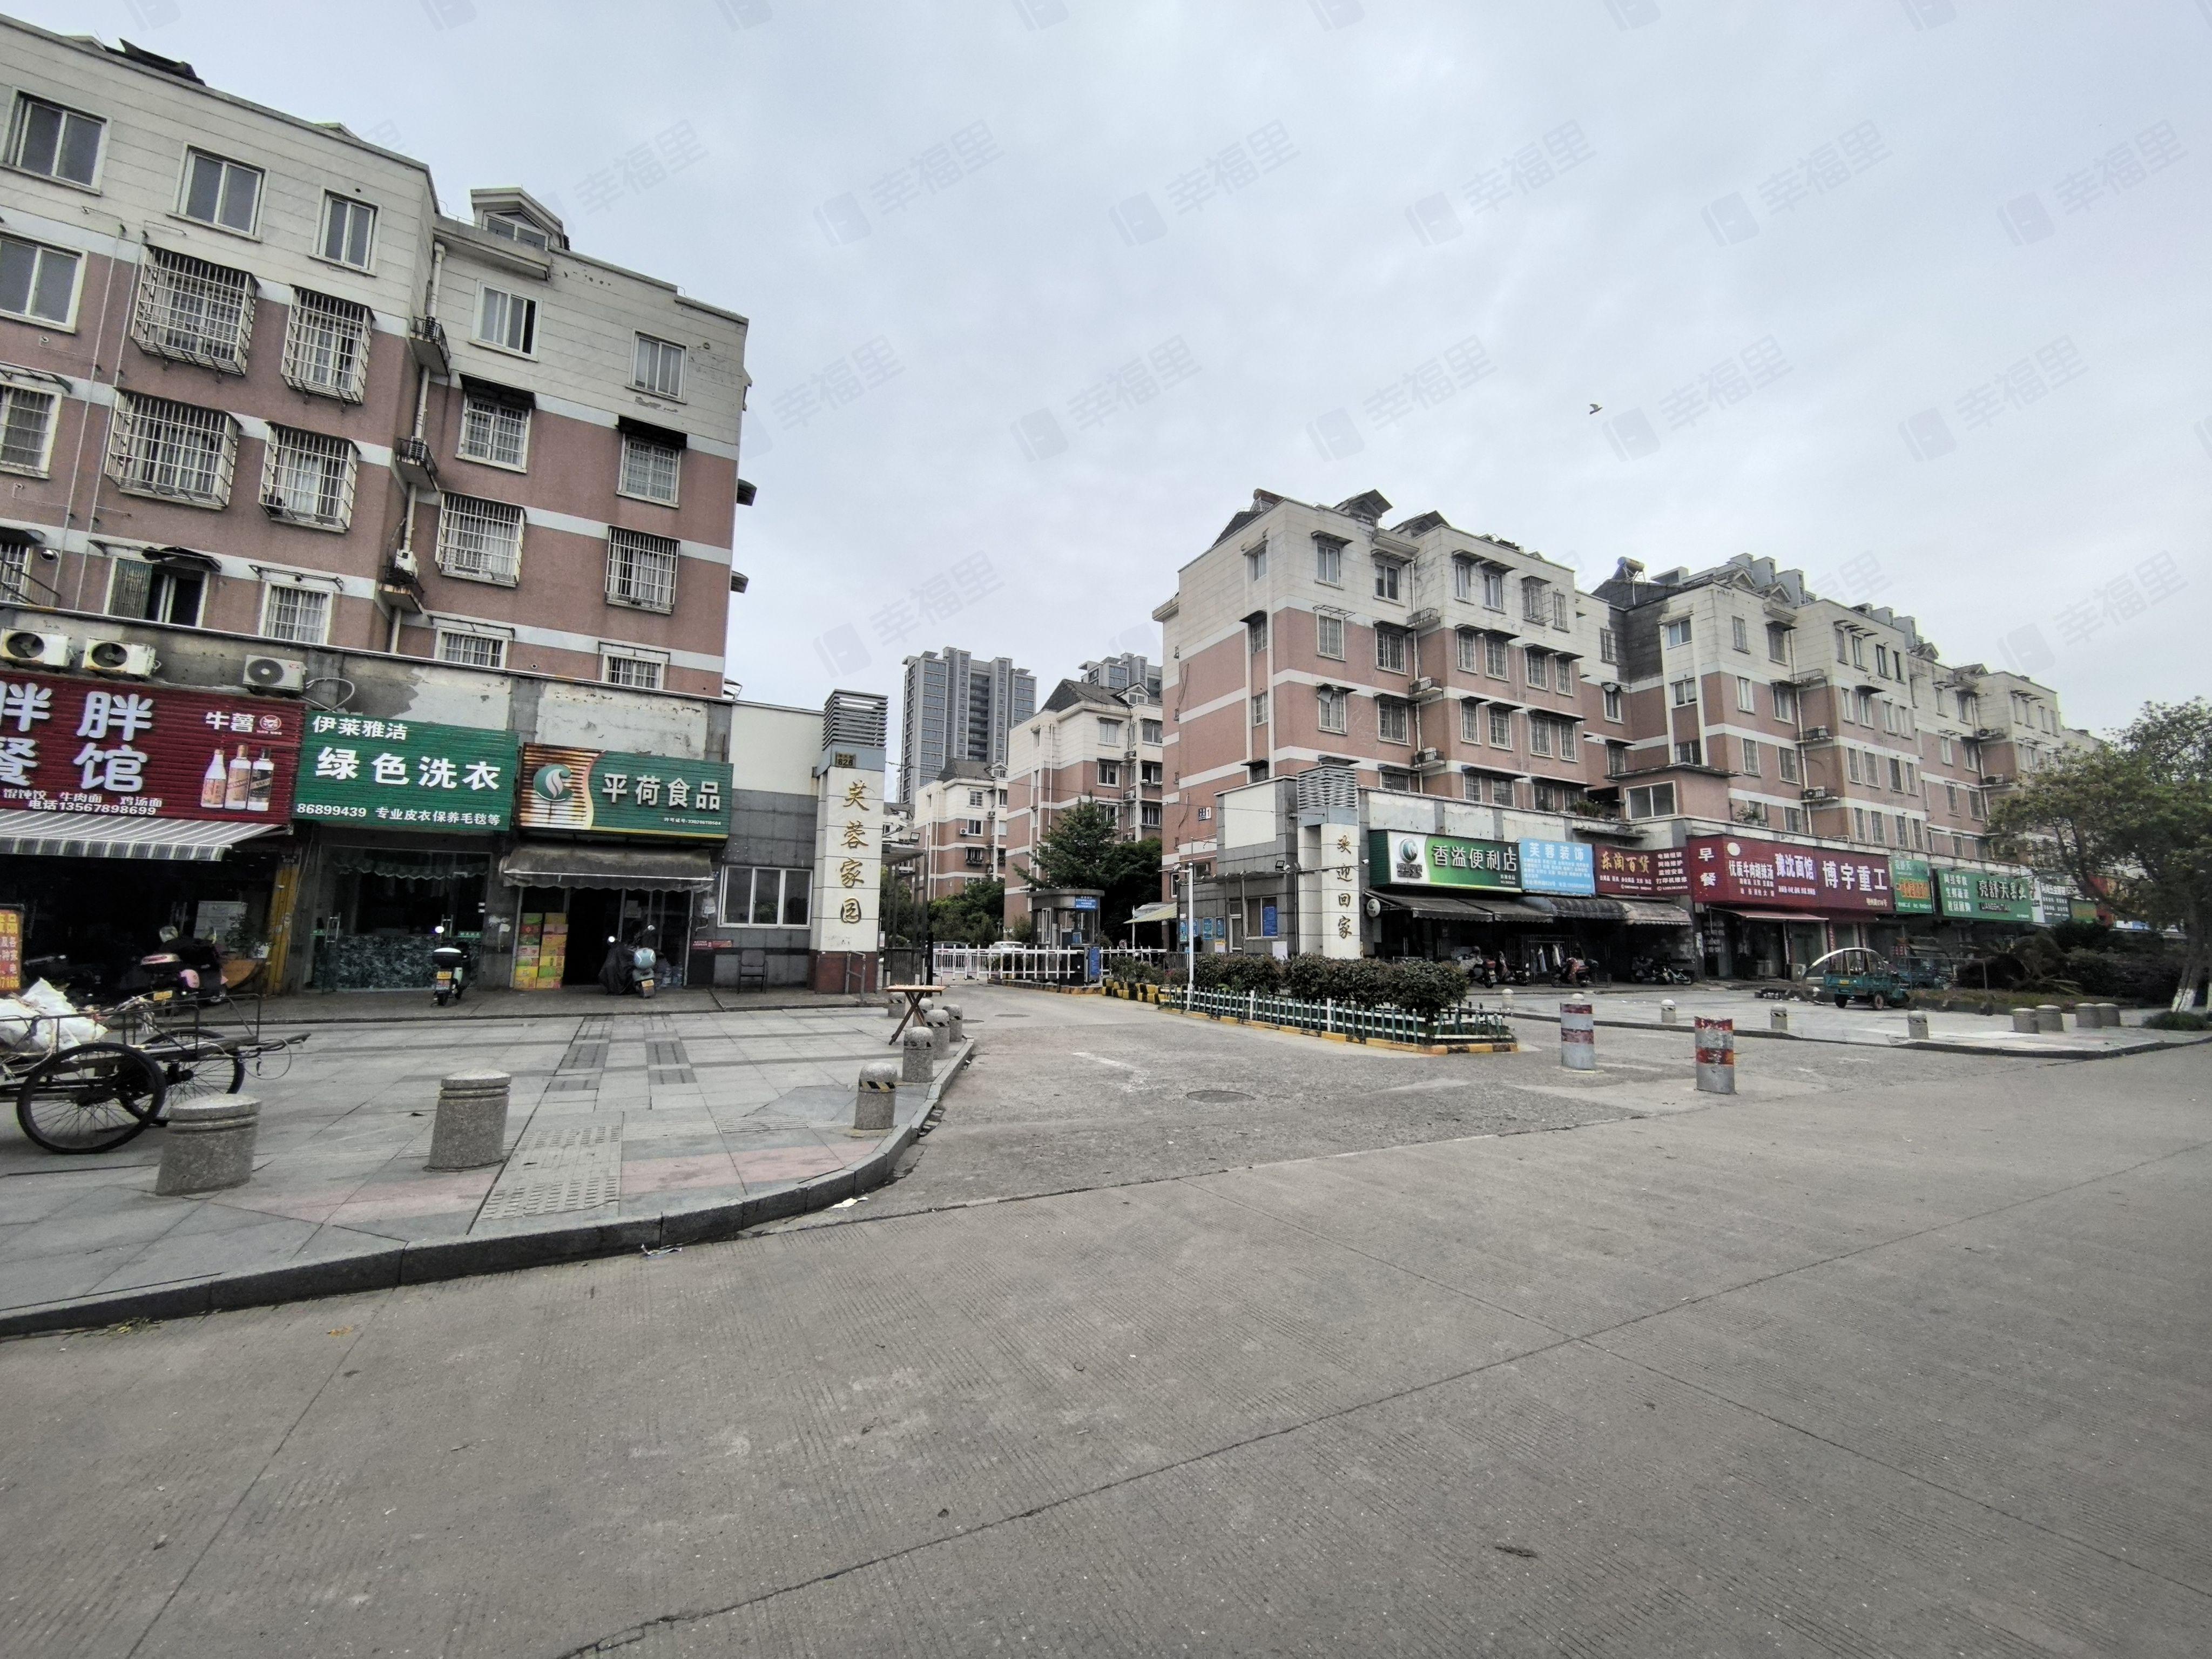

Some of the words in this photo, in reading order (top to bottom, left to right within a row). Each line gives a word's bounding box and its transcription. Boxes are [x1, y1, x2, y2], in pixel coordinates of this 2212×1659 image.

[312, 716, 408, 740] 伊莱雅洁
[315, 746, 501, 791] 绿色洗衣
[59, 792, 103, 804] 牛肉面
[120, 796, 163, 808] 鸡汤面
[602, 773, 720, 810] 平荷食品
[297, 803, 367, 818] 86899439
[375, 807, 501, 826] 专业皮衣保养毛毯等
[840, 779, 870, 924] 芙蓉家园
[1432, 845, 1516, 872] 香溢便利店
[1529, 842, 1584, 861] 芙蓉装饰
[1656, 876, 1687, 885] 打印机维修
[1698, 847, 1716, 886] 早餐
[1822, 860, 1887, 891] 博宇重工
[1337, 835, 1352, 939] 欢迎回家
